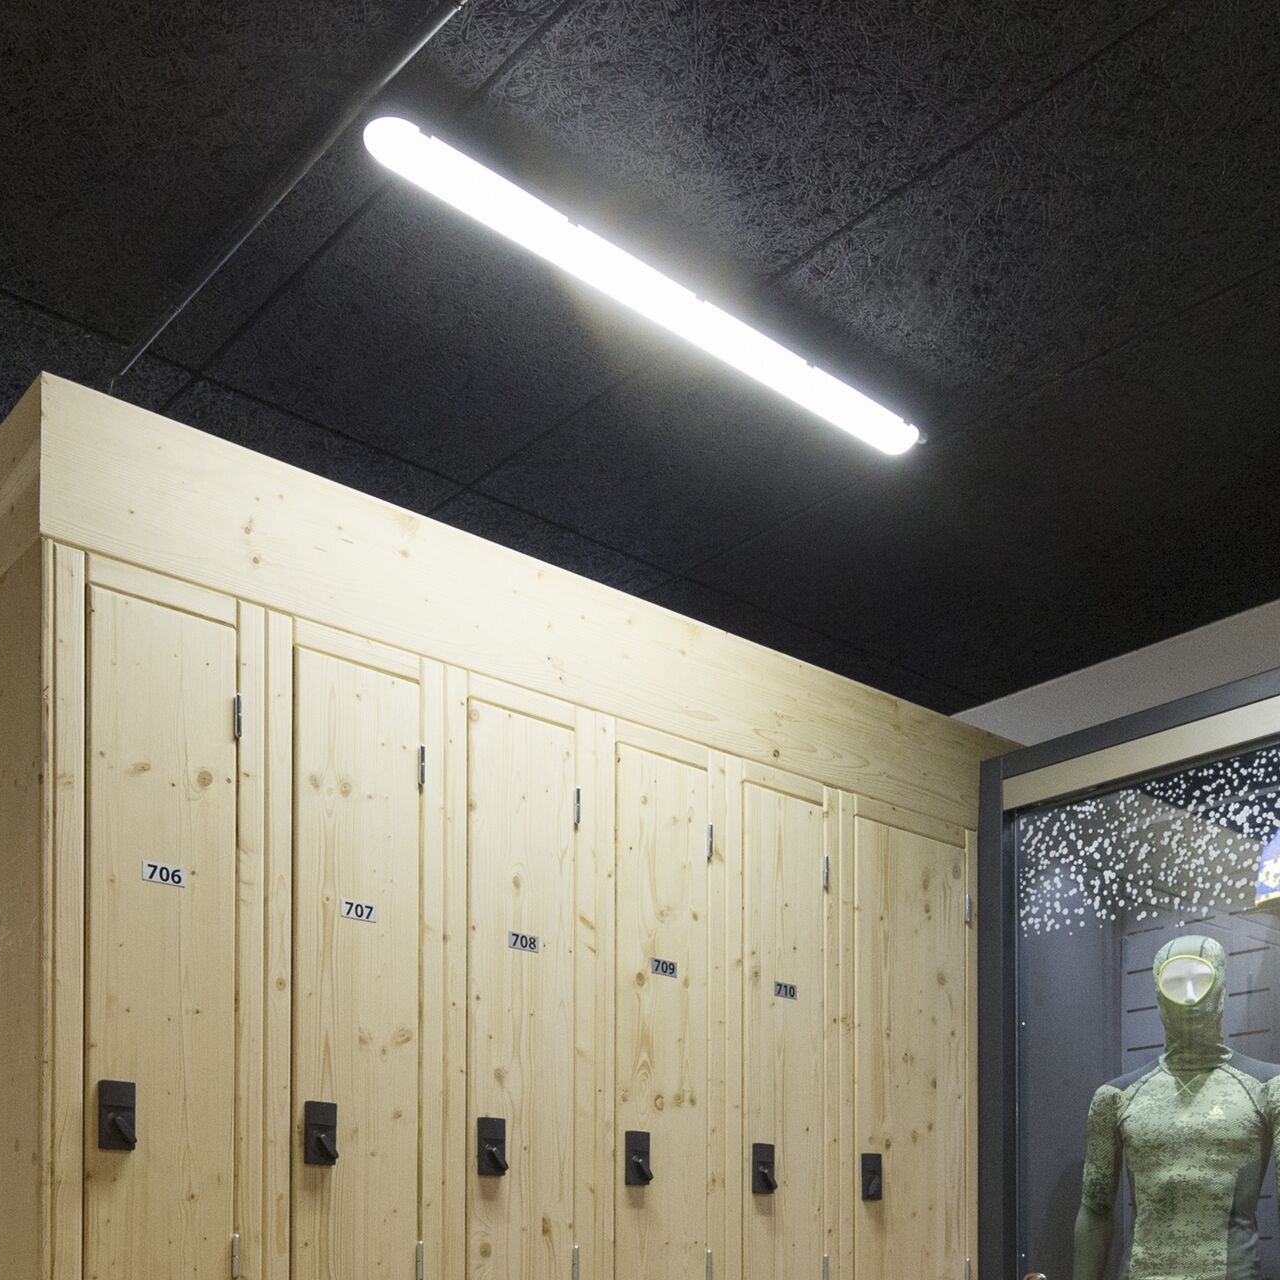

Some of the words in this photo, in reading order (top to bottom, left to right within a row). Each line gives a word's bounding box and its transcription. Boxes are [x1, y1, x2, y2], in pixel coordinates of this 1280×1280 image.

[147, 863, 182, 884] 706
[345, 901, 374, 920] 707
[511, 933, 537, 950] 708
[654, 959, 676, 975] 709
[776, 983, 795, 998] 710
